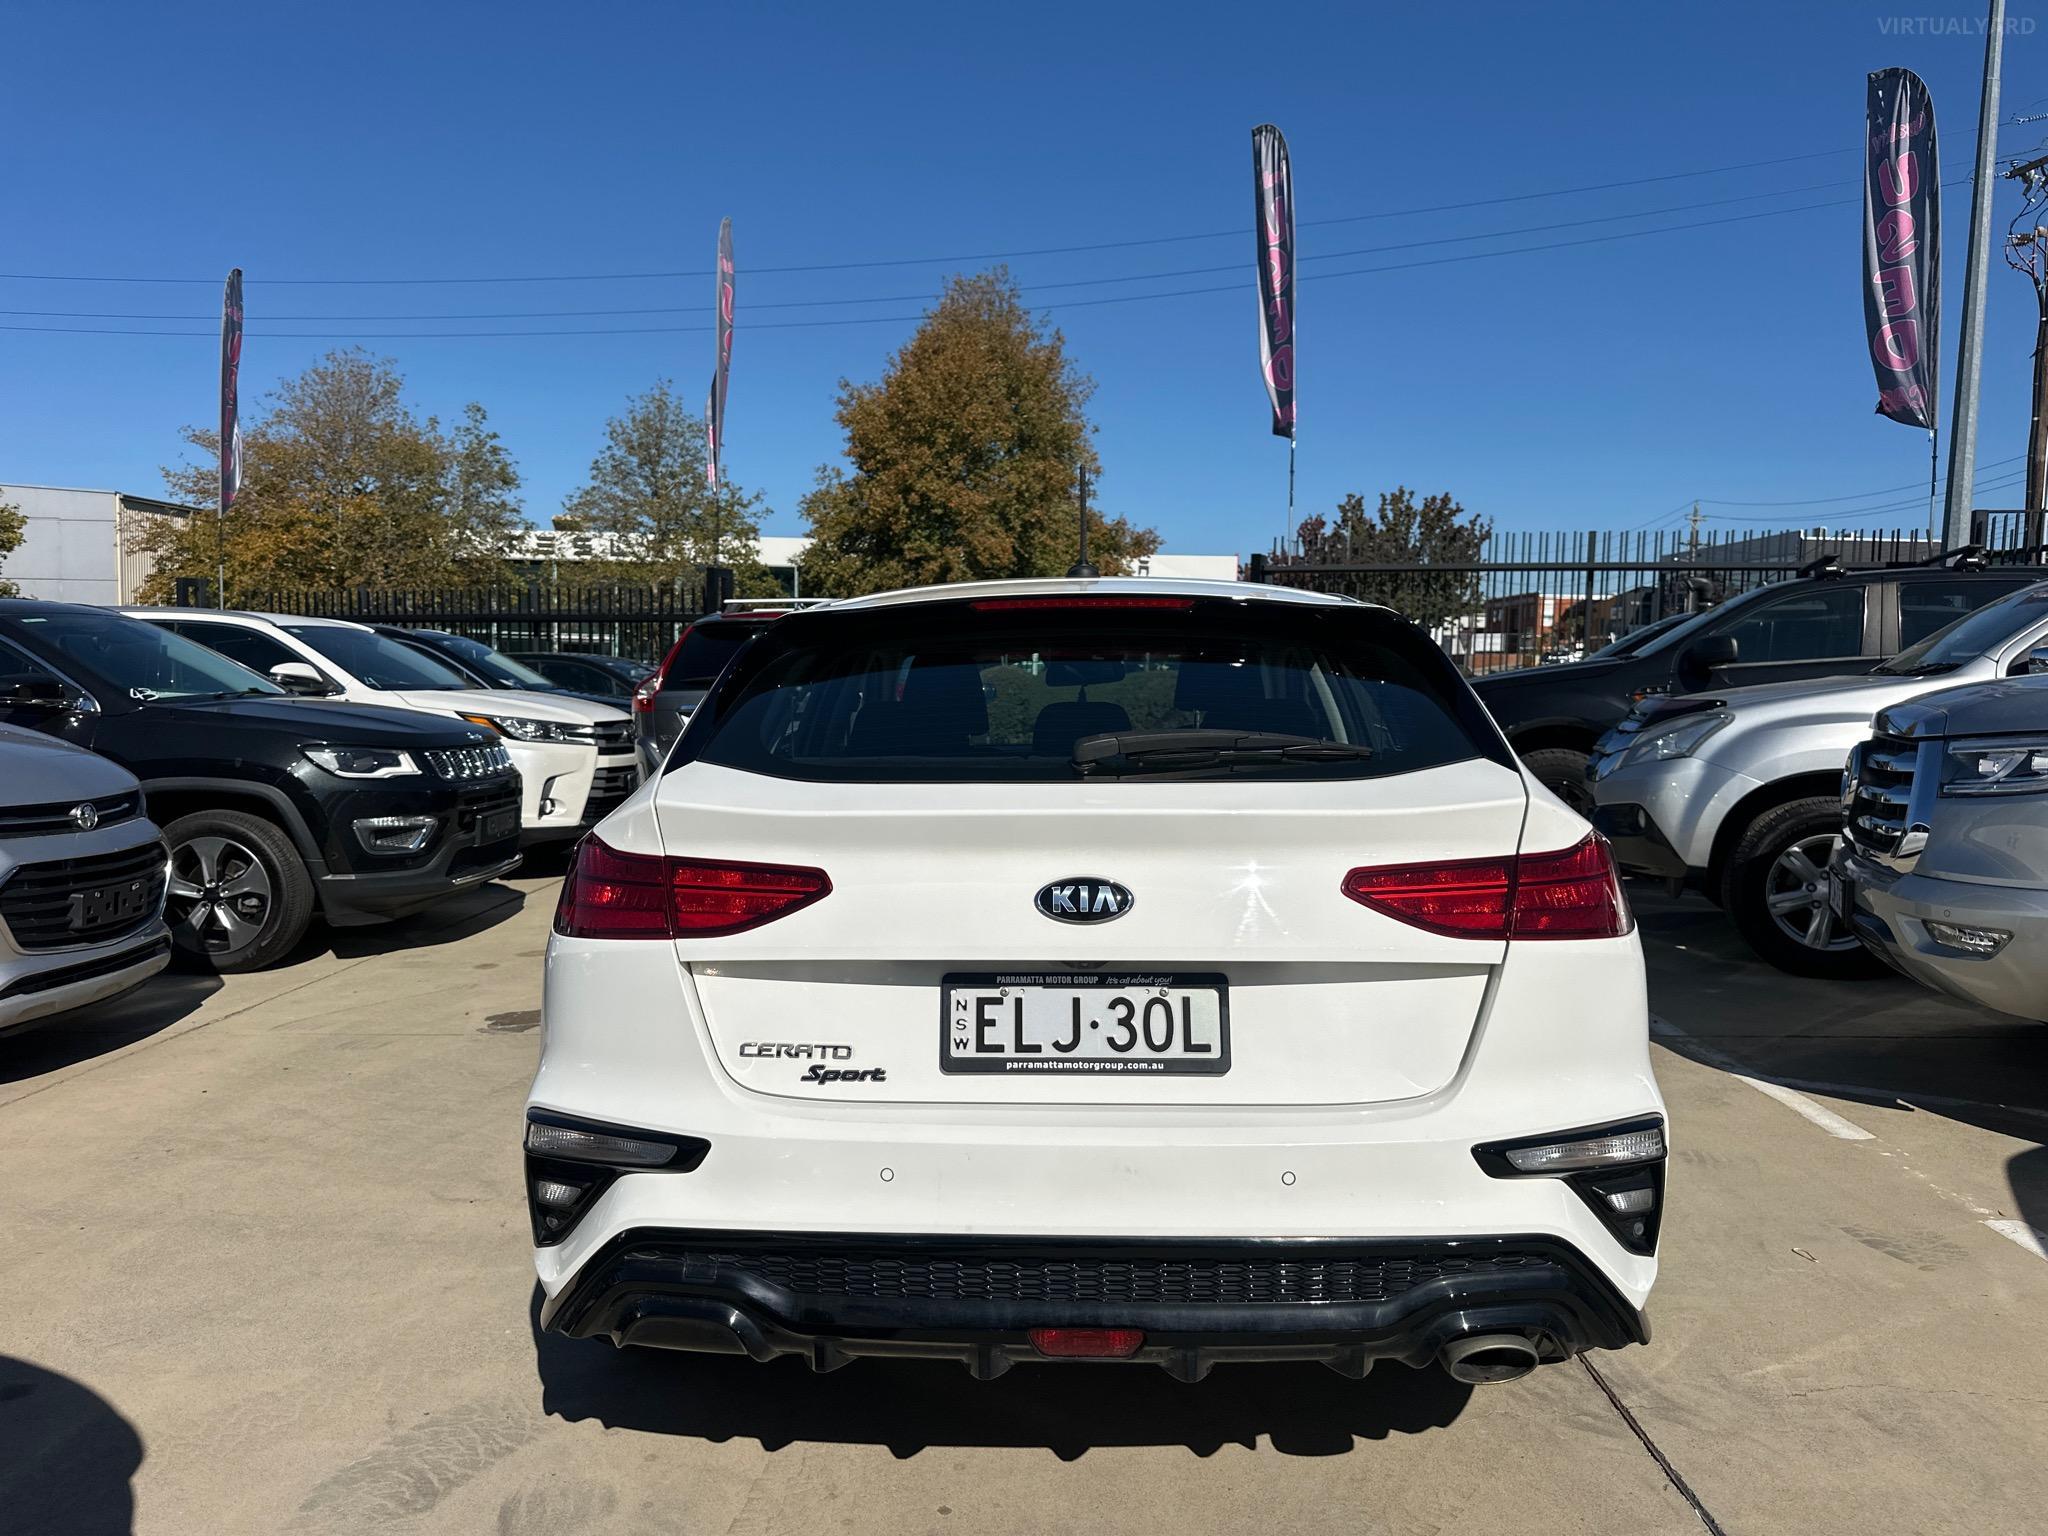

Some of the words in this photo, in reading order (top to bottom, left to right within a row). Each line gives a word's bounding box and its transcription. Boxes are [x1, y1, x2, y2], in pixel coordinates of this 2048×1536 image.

[1051, 885, 1118, 912] KIA
[996, 975, 1044, 984] PARRAMATTA
[1045, 975, 1071, 984] MOTOR
[1073, 975, 1099, 984] GROUP
[1119, 976, 1130, 984] all
[1131, 974, 1153, 984] about
[1154, 975, 1173, 986] you!
[739, 1042, 852, 1060] CERATO
[1006, 1060, 1164, 1071] parramattamotorgroup.com.au
[800, 1064, 887, 1085] Sport
